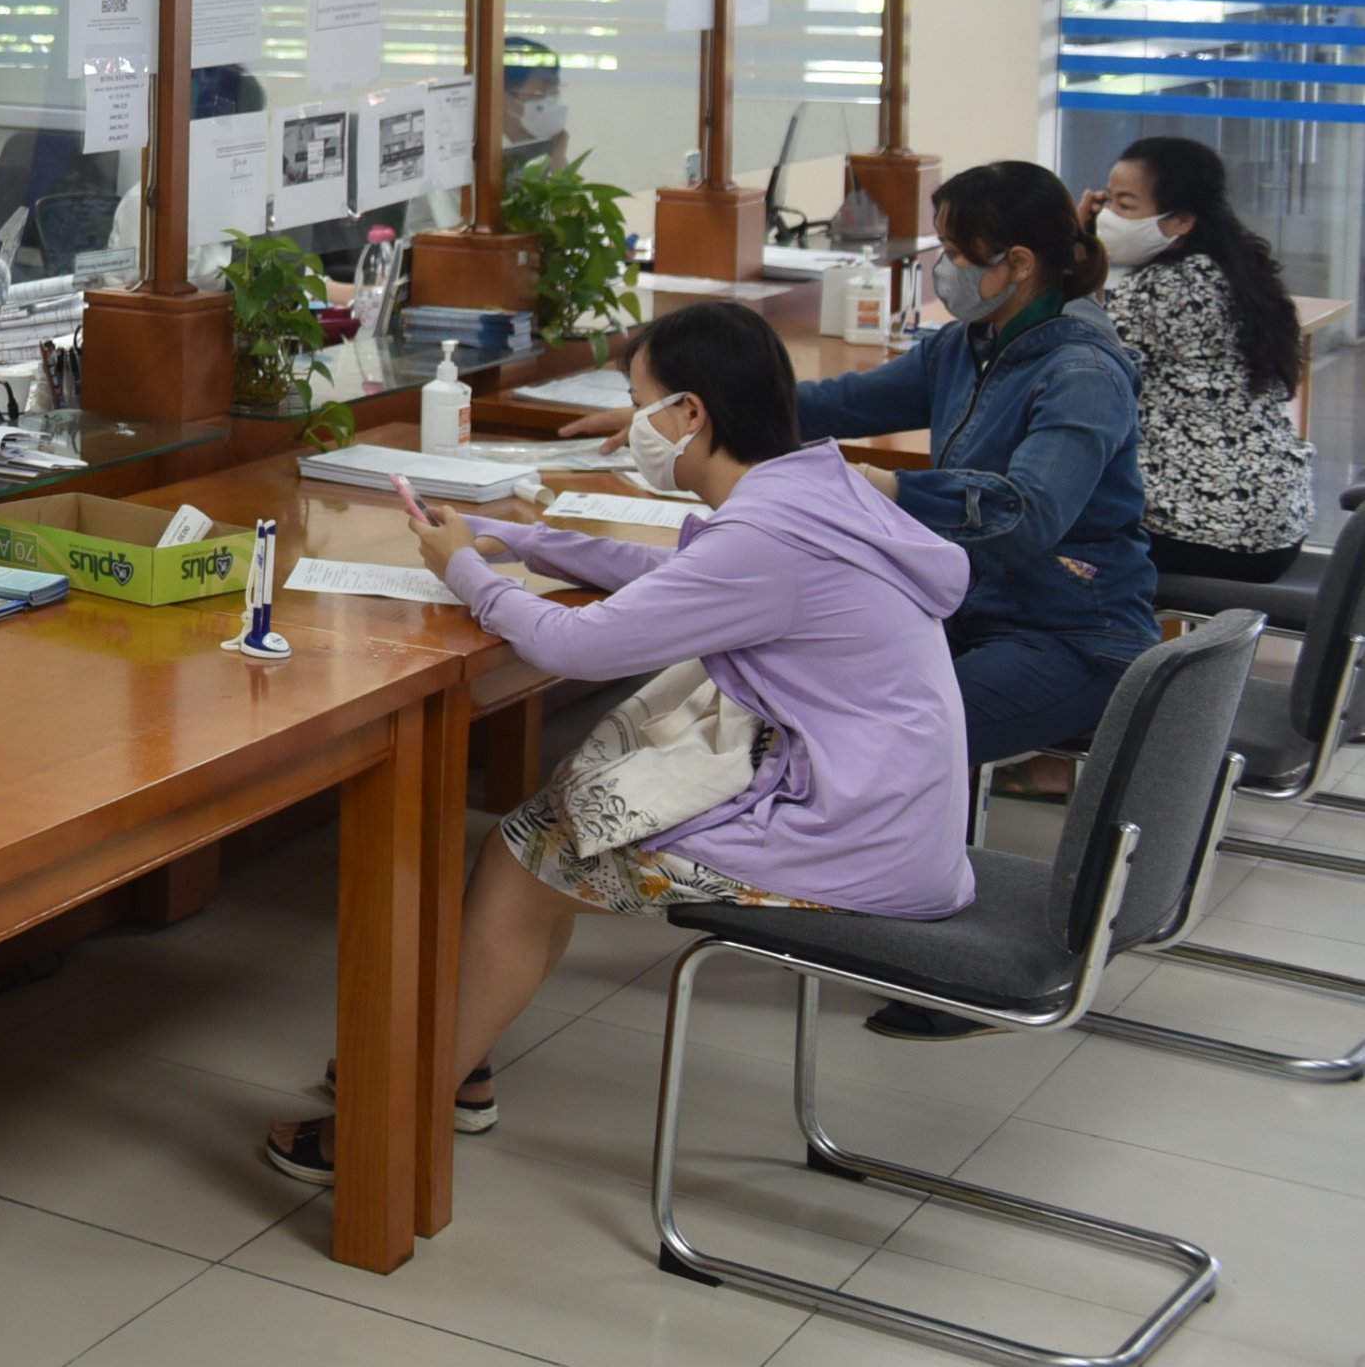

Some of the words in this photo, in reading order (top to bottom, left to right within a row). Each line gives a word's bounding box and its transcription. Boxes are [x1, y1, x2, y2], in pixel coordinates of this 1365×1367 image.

[15, 540, 36, 563] 70
[69, 546, 113, 581] plus
[181, 548, 217, 584] plus
